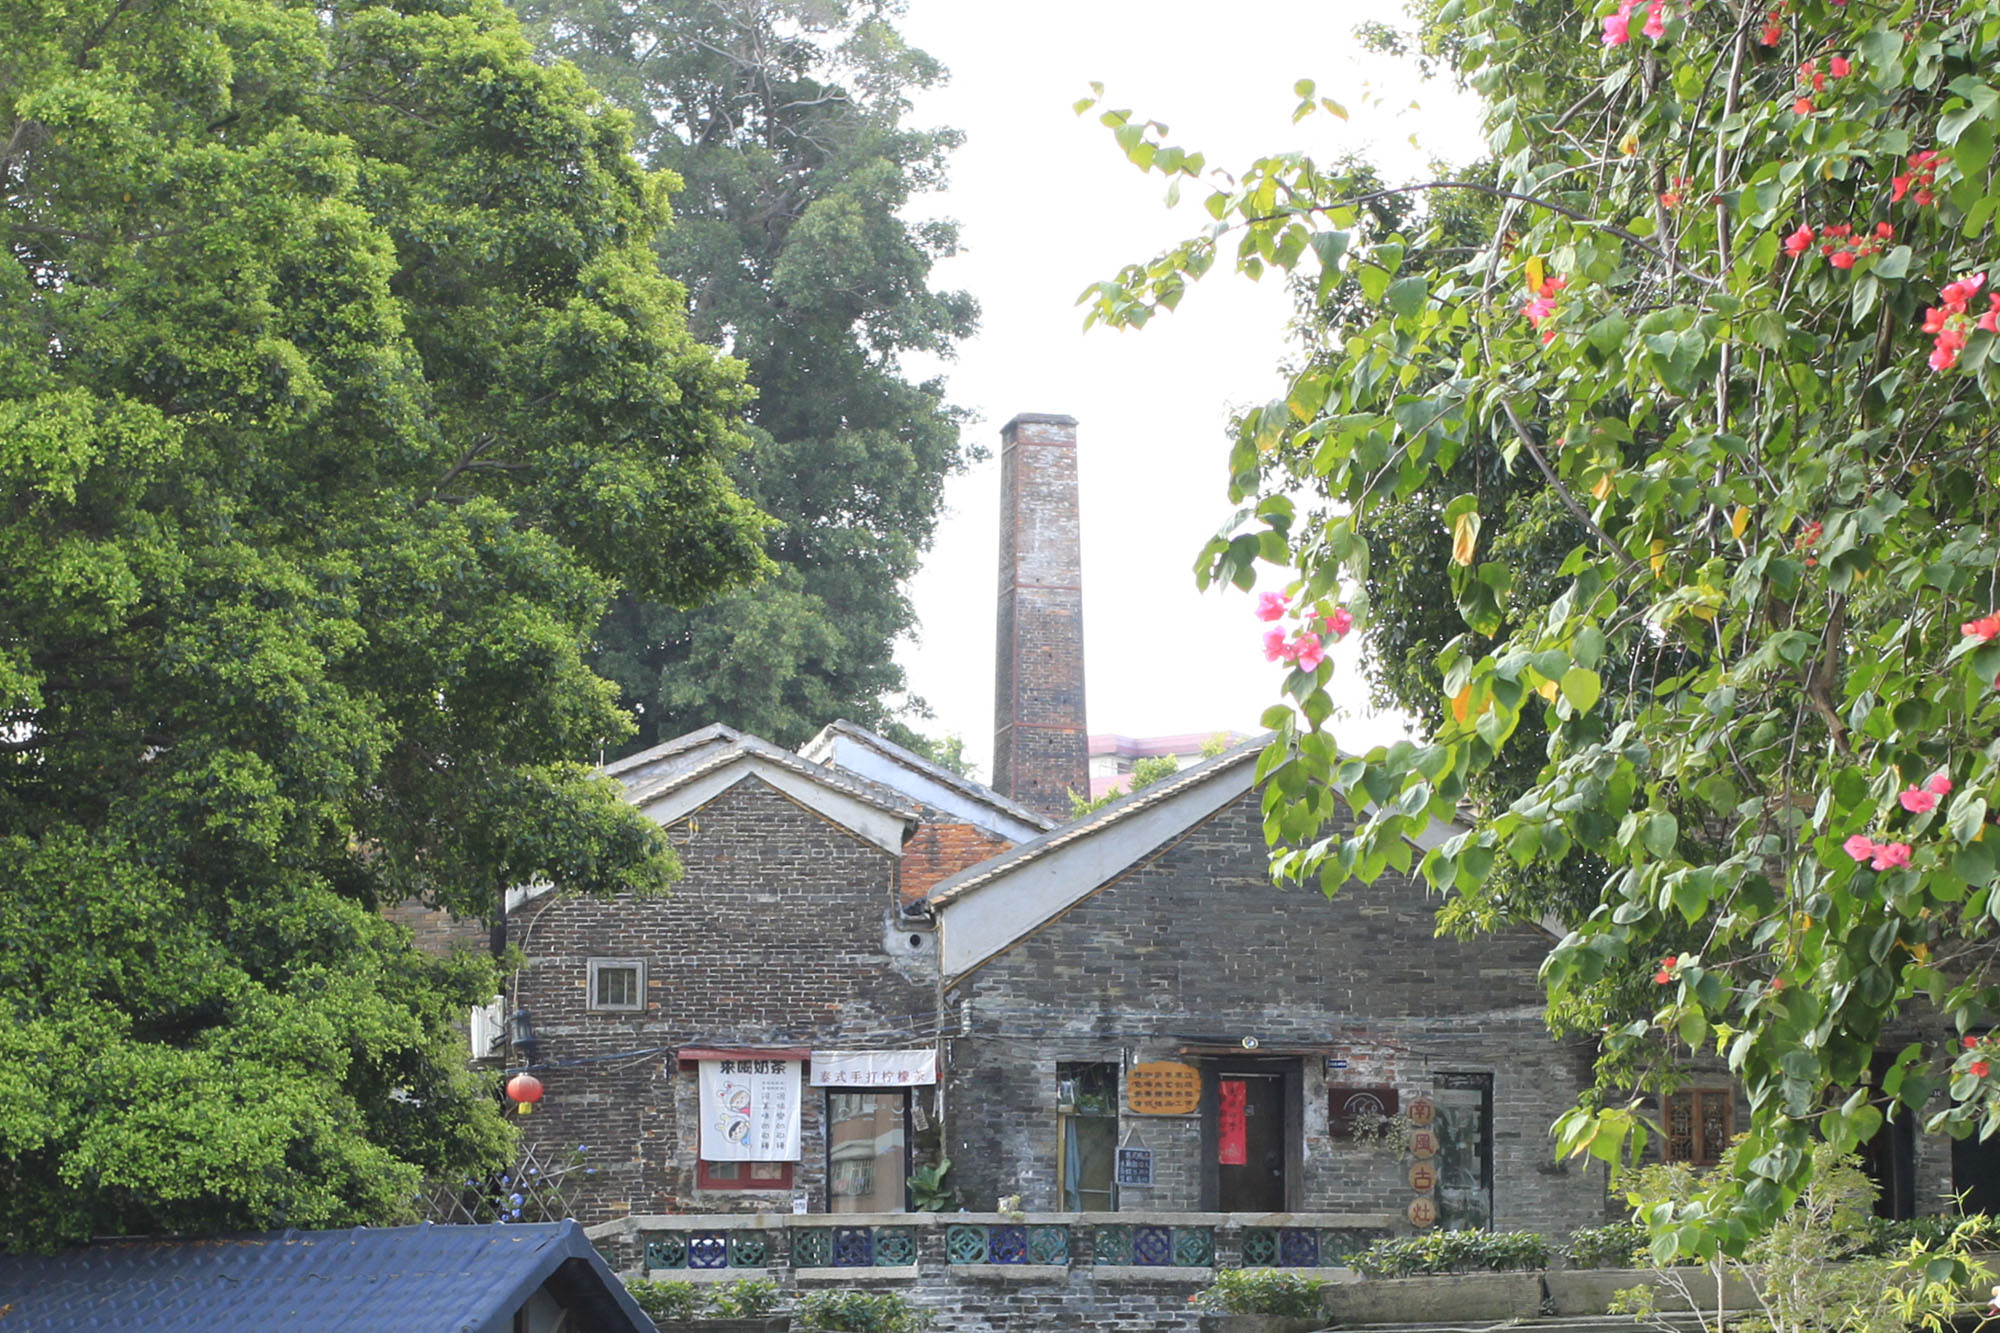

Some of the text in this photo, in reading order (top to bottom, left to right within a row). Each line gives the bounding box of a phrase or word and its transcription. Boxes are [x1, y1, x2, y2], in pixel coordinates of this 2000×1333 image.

[720, 1060, 787, 1074] 来喝奶茶
[819, 1069, 926, 1084] 泰式手打柠檬茶
[1409, 1100, 1434, 1223] 南風古灶
